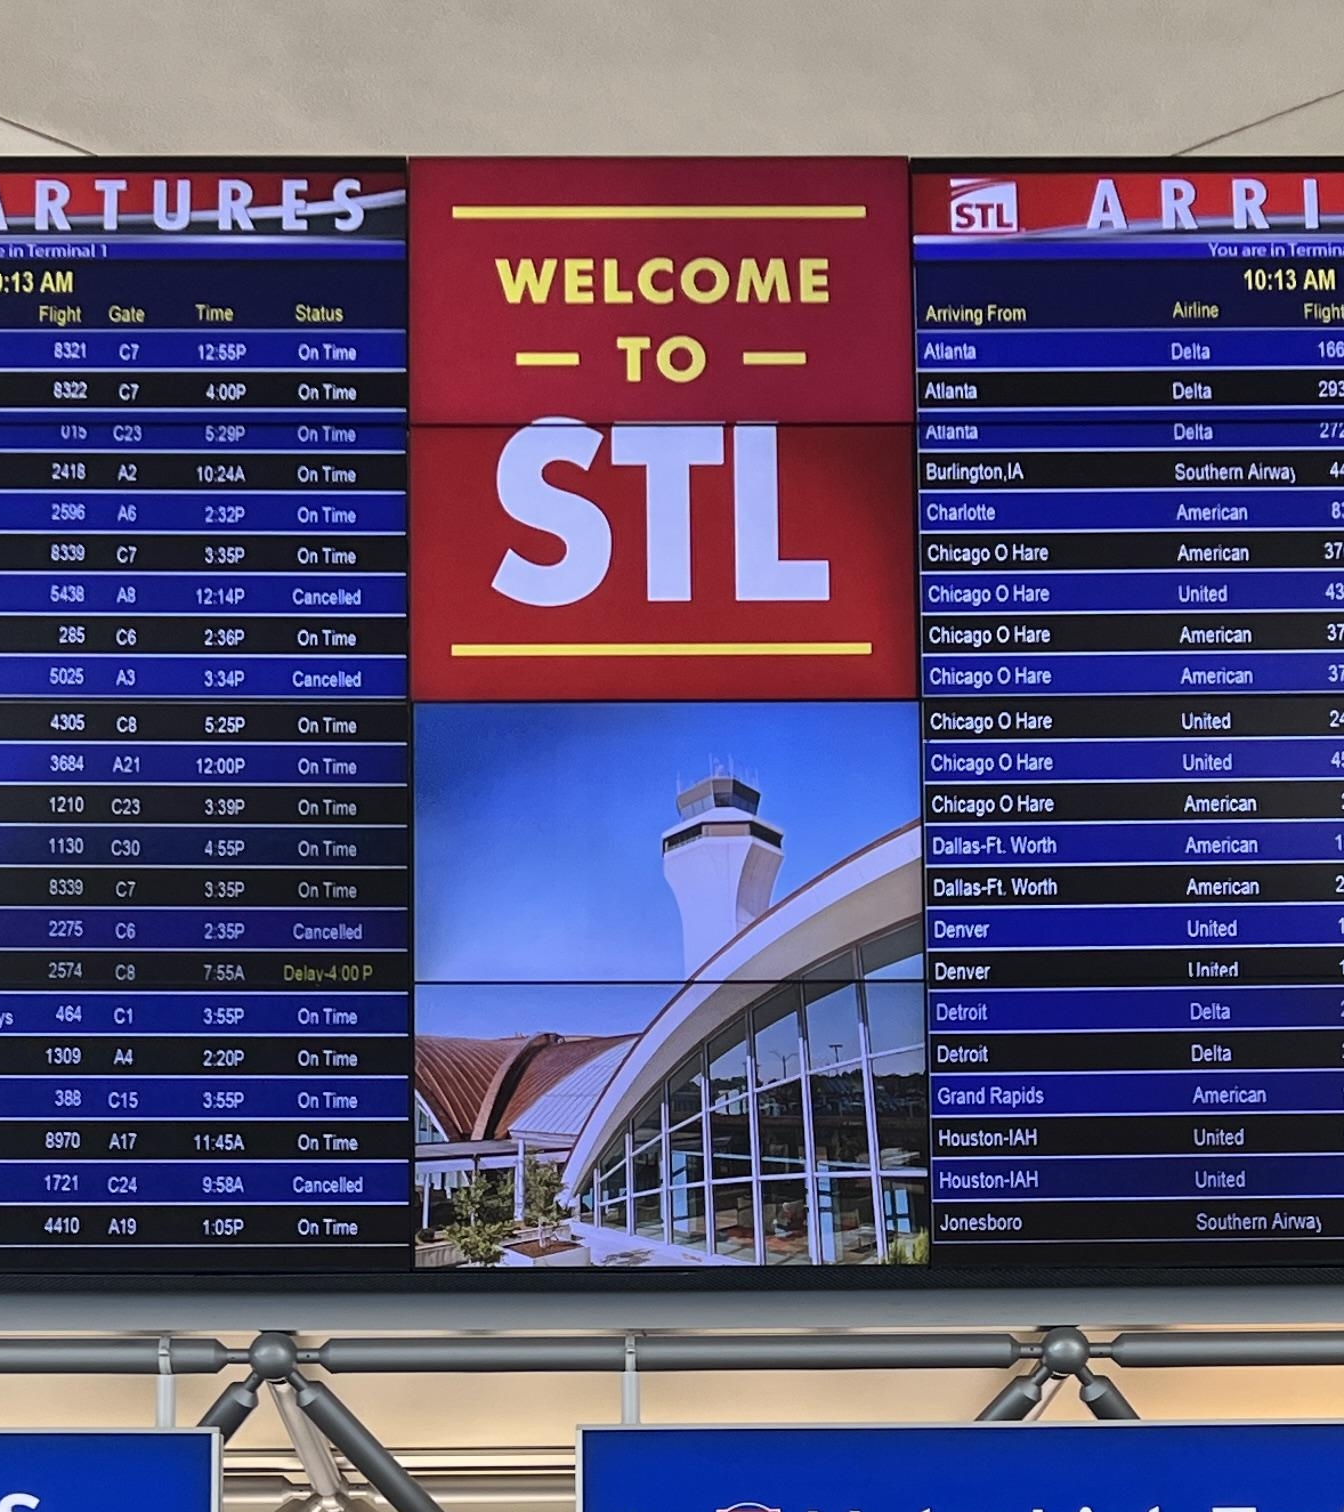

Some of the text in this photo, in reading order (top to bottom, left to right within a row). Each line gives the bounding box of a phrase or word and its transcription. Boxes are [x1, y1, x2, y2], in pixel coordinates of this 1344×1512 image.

[955, 204, 1014, 229] STL
[40, 272, 73, 293] AM
[495, 258, 830, 304] WELCOME
[1244, 269, 1336, 291] 10:13 AM
[925, 305, 1026, 325] Arriving From
[617, 335, 707, 383] TO
[491, 415, 831, 607] STL
[49, 587, 85, 603] 5438
[117, 588, 136, 604] A8
[196, 589, 246, 606] 12:14P
[293, 589, 361, 605] Cancelled
[932, 836, 1005, 856] Dallas-Ft.
[1011, 836, 1057, 854] Worth
[1186, 836, 1258, 854] American
